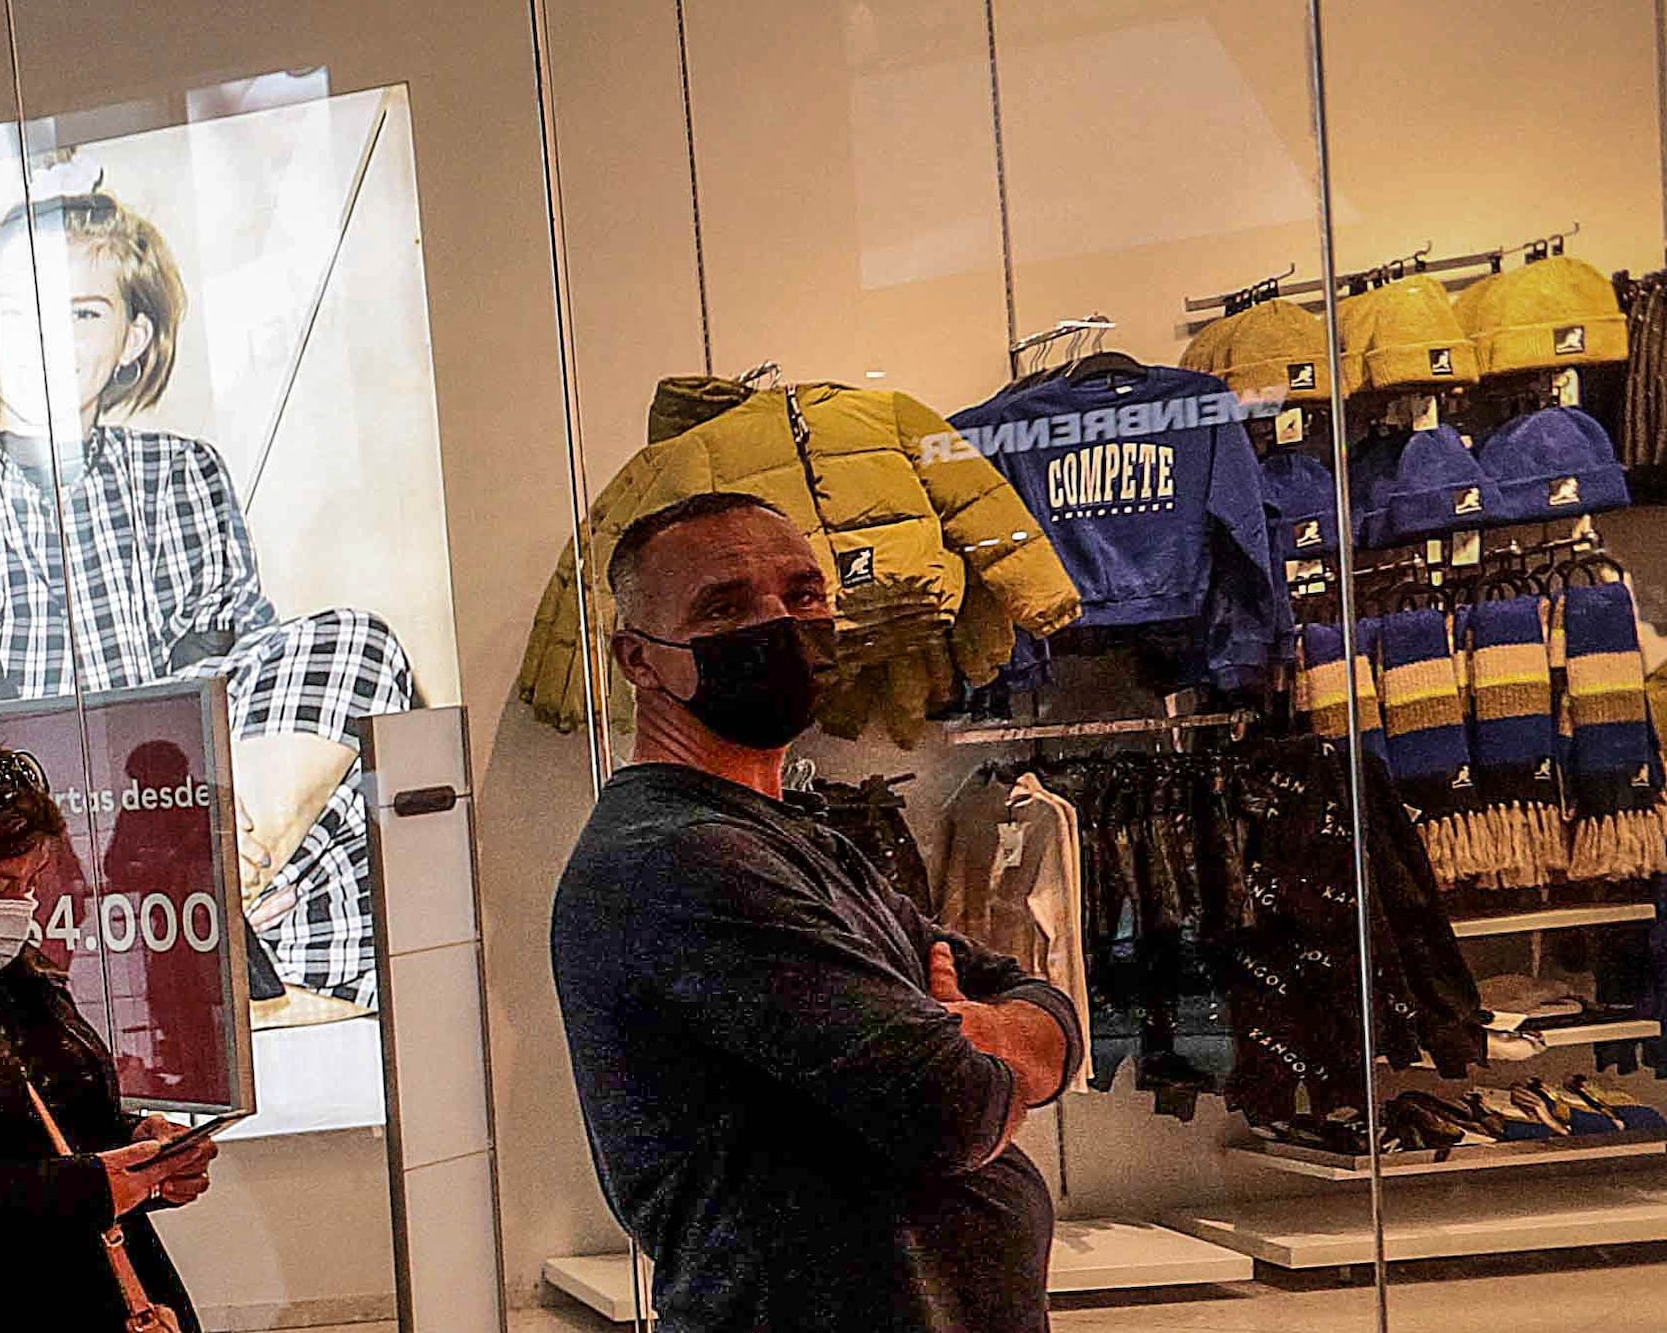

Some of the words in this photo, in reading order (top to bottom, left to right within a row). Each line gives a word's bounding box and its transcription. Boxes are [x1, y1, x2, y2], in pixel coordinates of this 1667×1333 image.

[1048, 442, 1175, 508] COMPETE
[52, 786, 115, 814] rtas
[121, 774, 210, 811] desde
